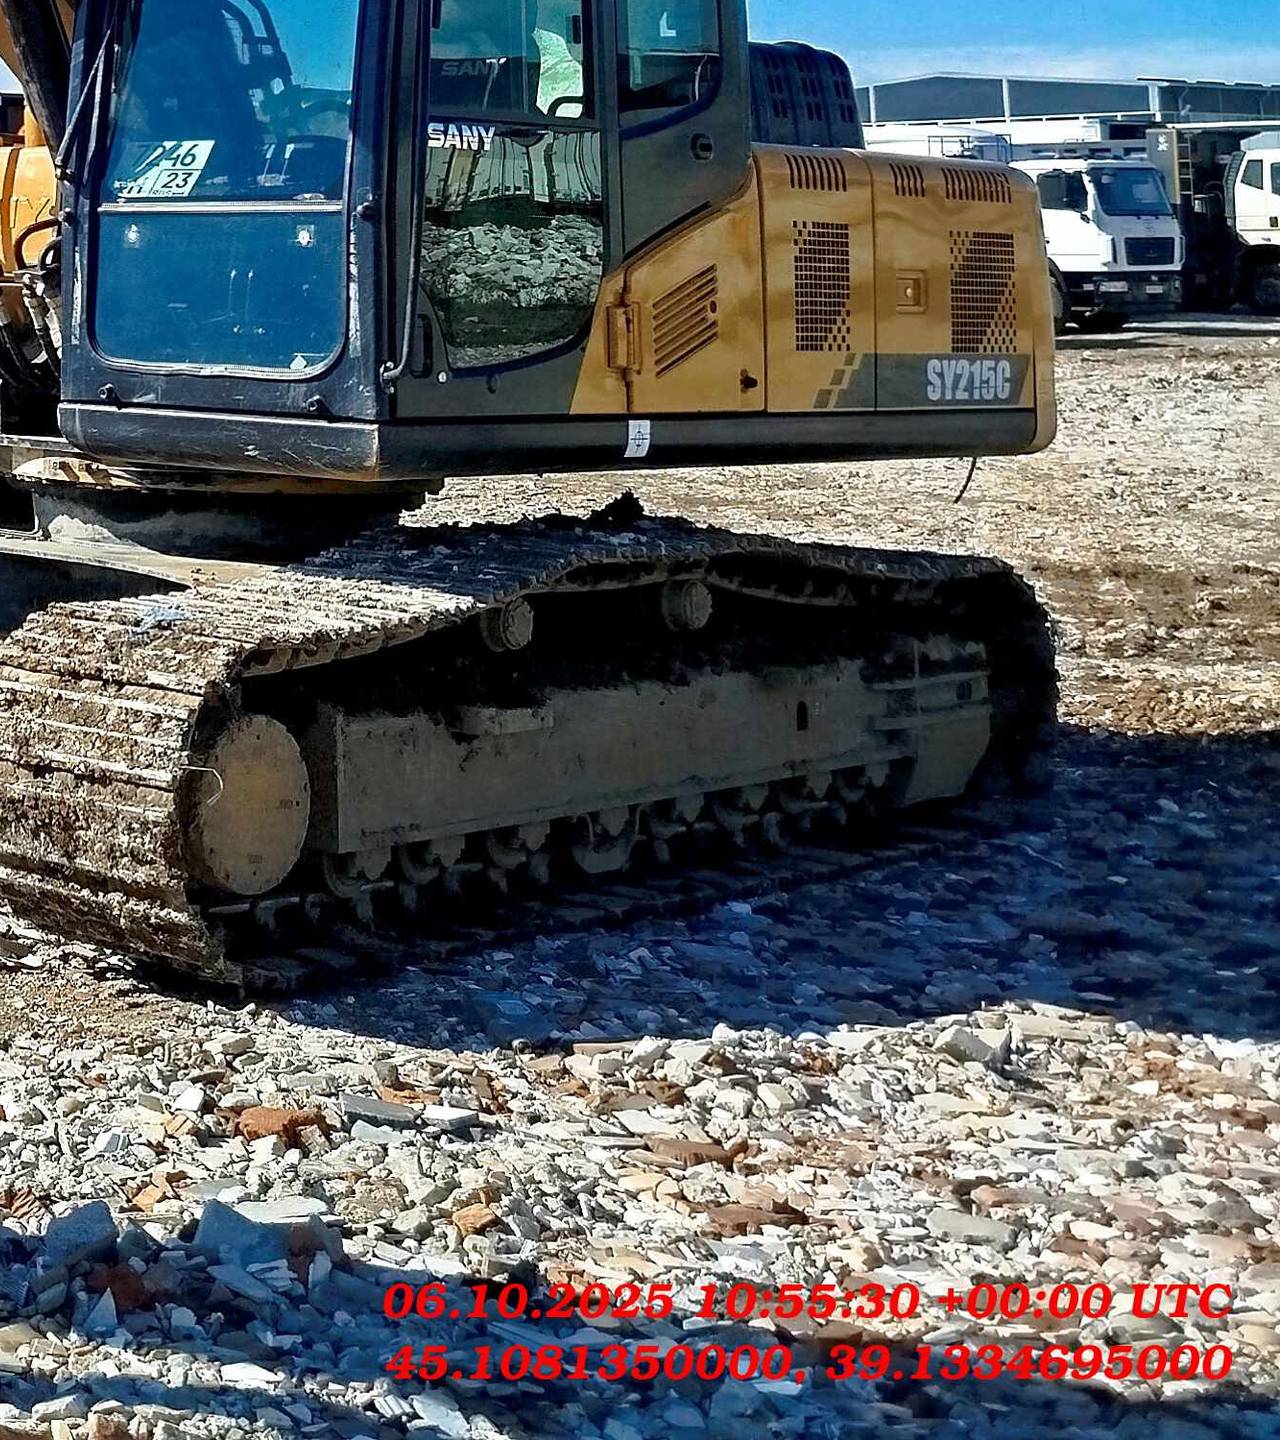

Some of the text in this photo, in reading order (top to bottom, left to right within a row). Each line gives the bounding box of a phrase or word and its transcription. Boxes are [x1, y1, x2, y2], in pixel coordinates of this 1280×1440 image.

[427, 122, 496, 152] SANY
[160, 172, 194, 189] 23
[926, 358, 1011, 401] SY215C
